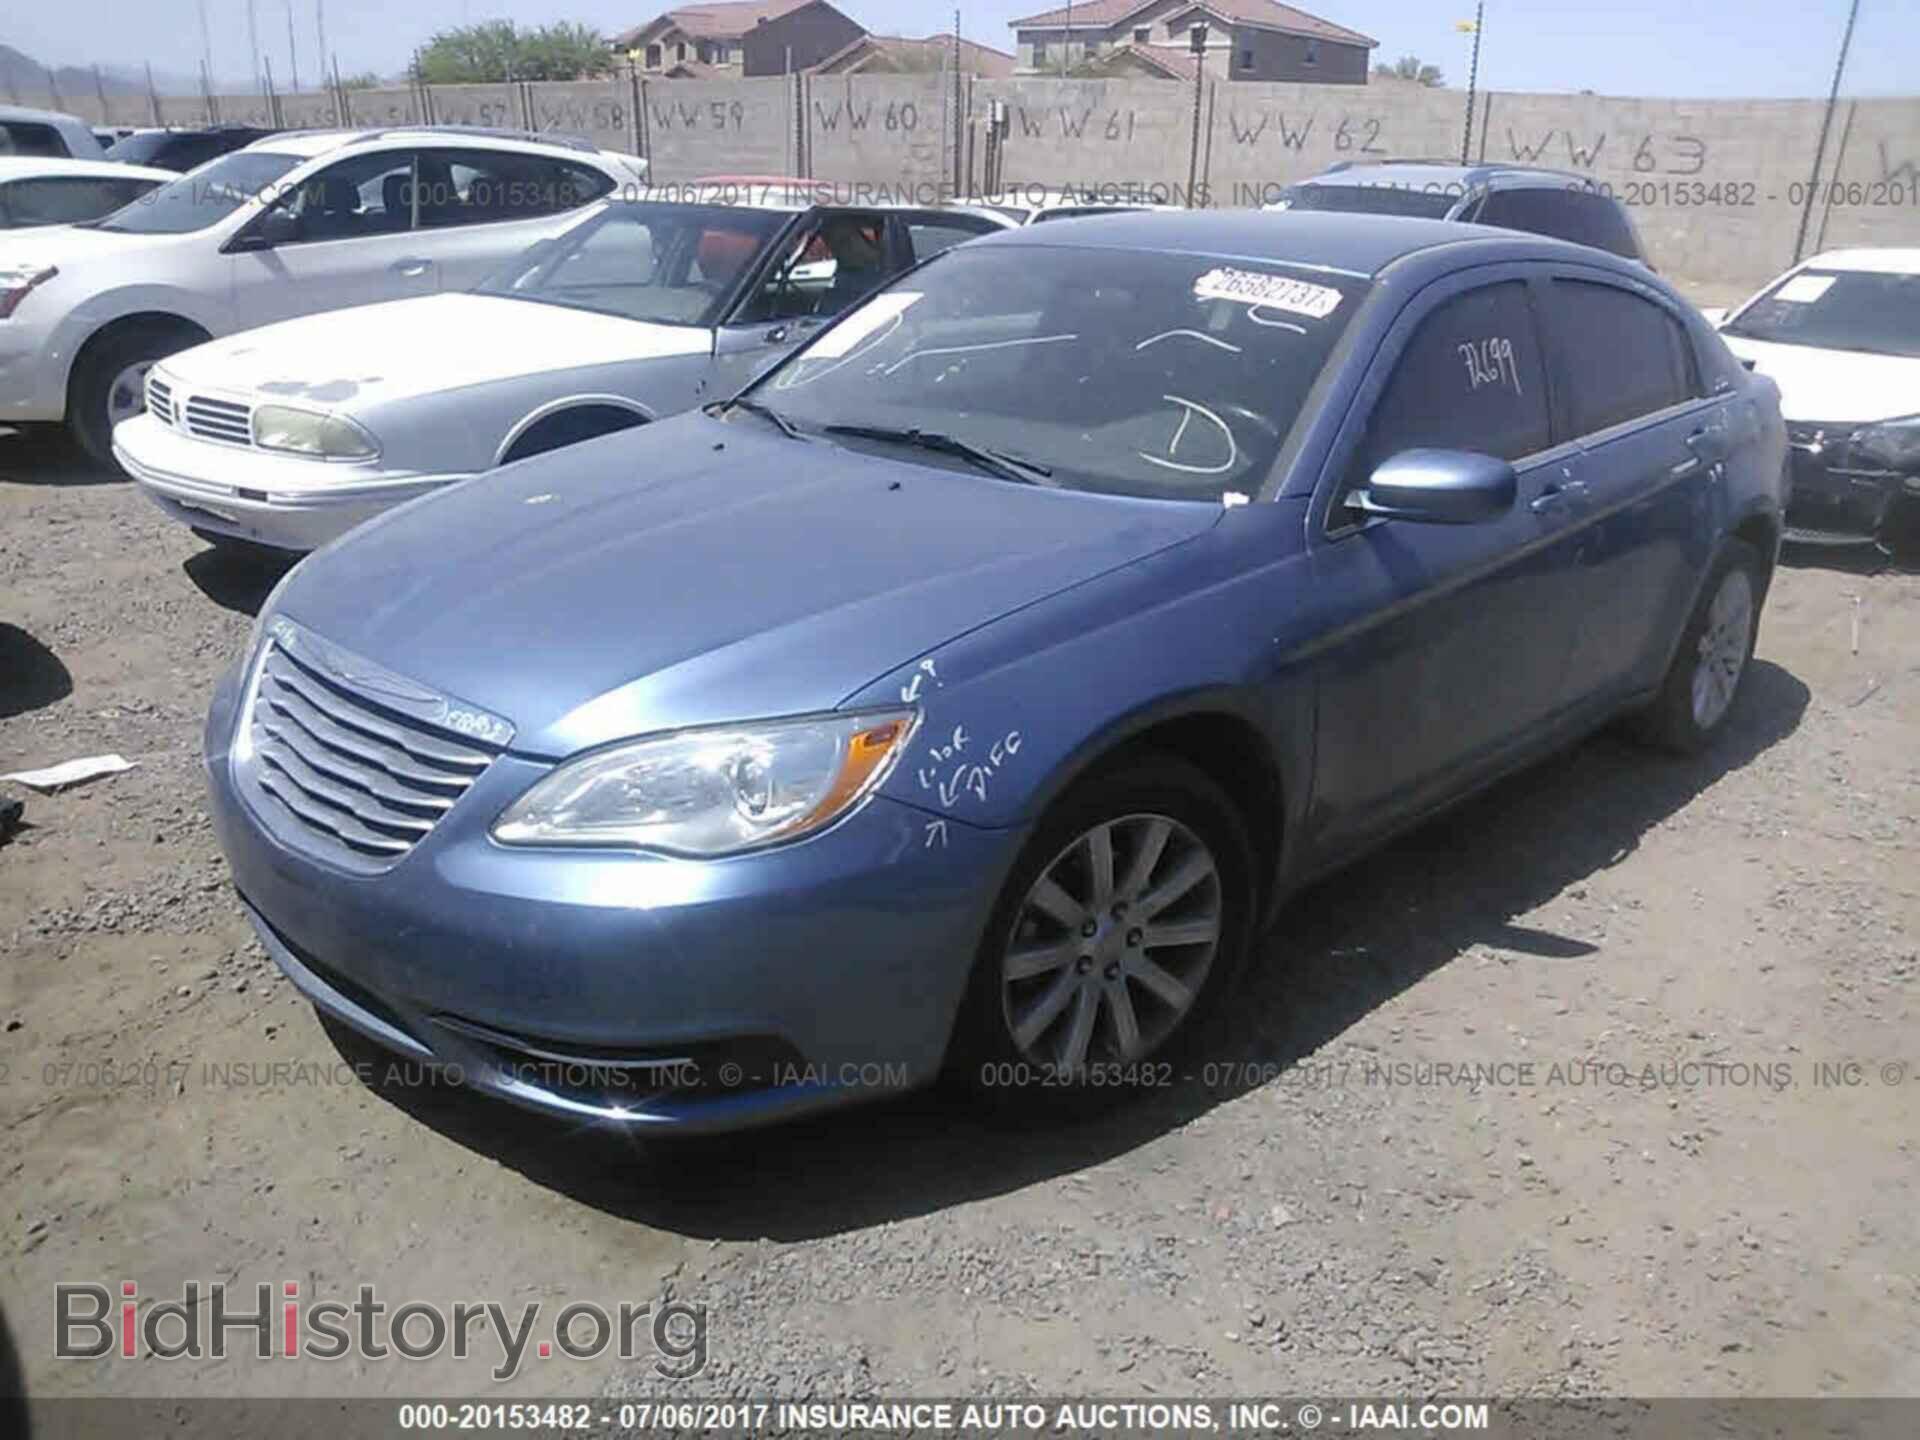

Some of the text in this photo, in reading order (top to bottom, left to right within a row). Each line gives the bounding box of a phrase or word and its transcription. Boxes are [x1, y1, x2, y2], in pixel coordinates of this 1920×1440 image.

[594, 103, 624, 130] 58
[711, 102, 743, 131] 59
[885, 103, 917, 131] 60
[1104, 109, 1134, 141] 61
[1334, 118, 1386, 153] 62
[1632, 134, 1707, 175] 63
